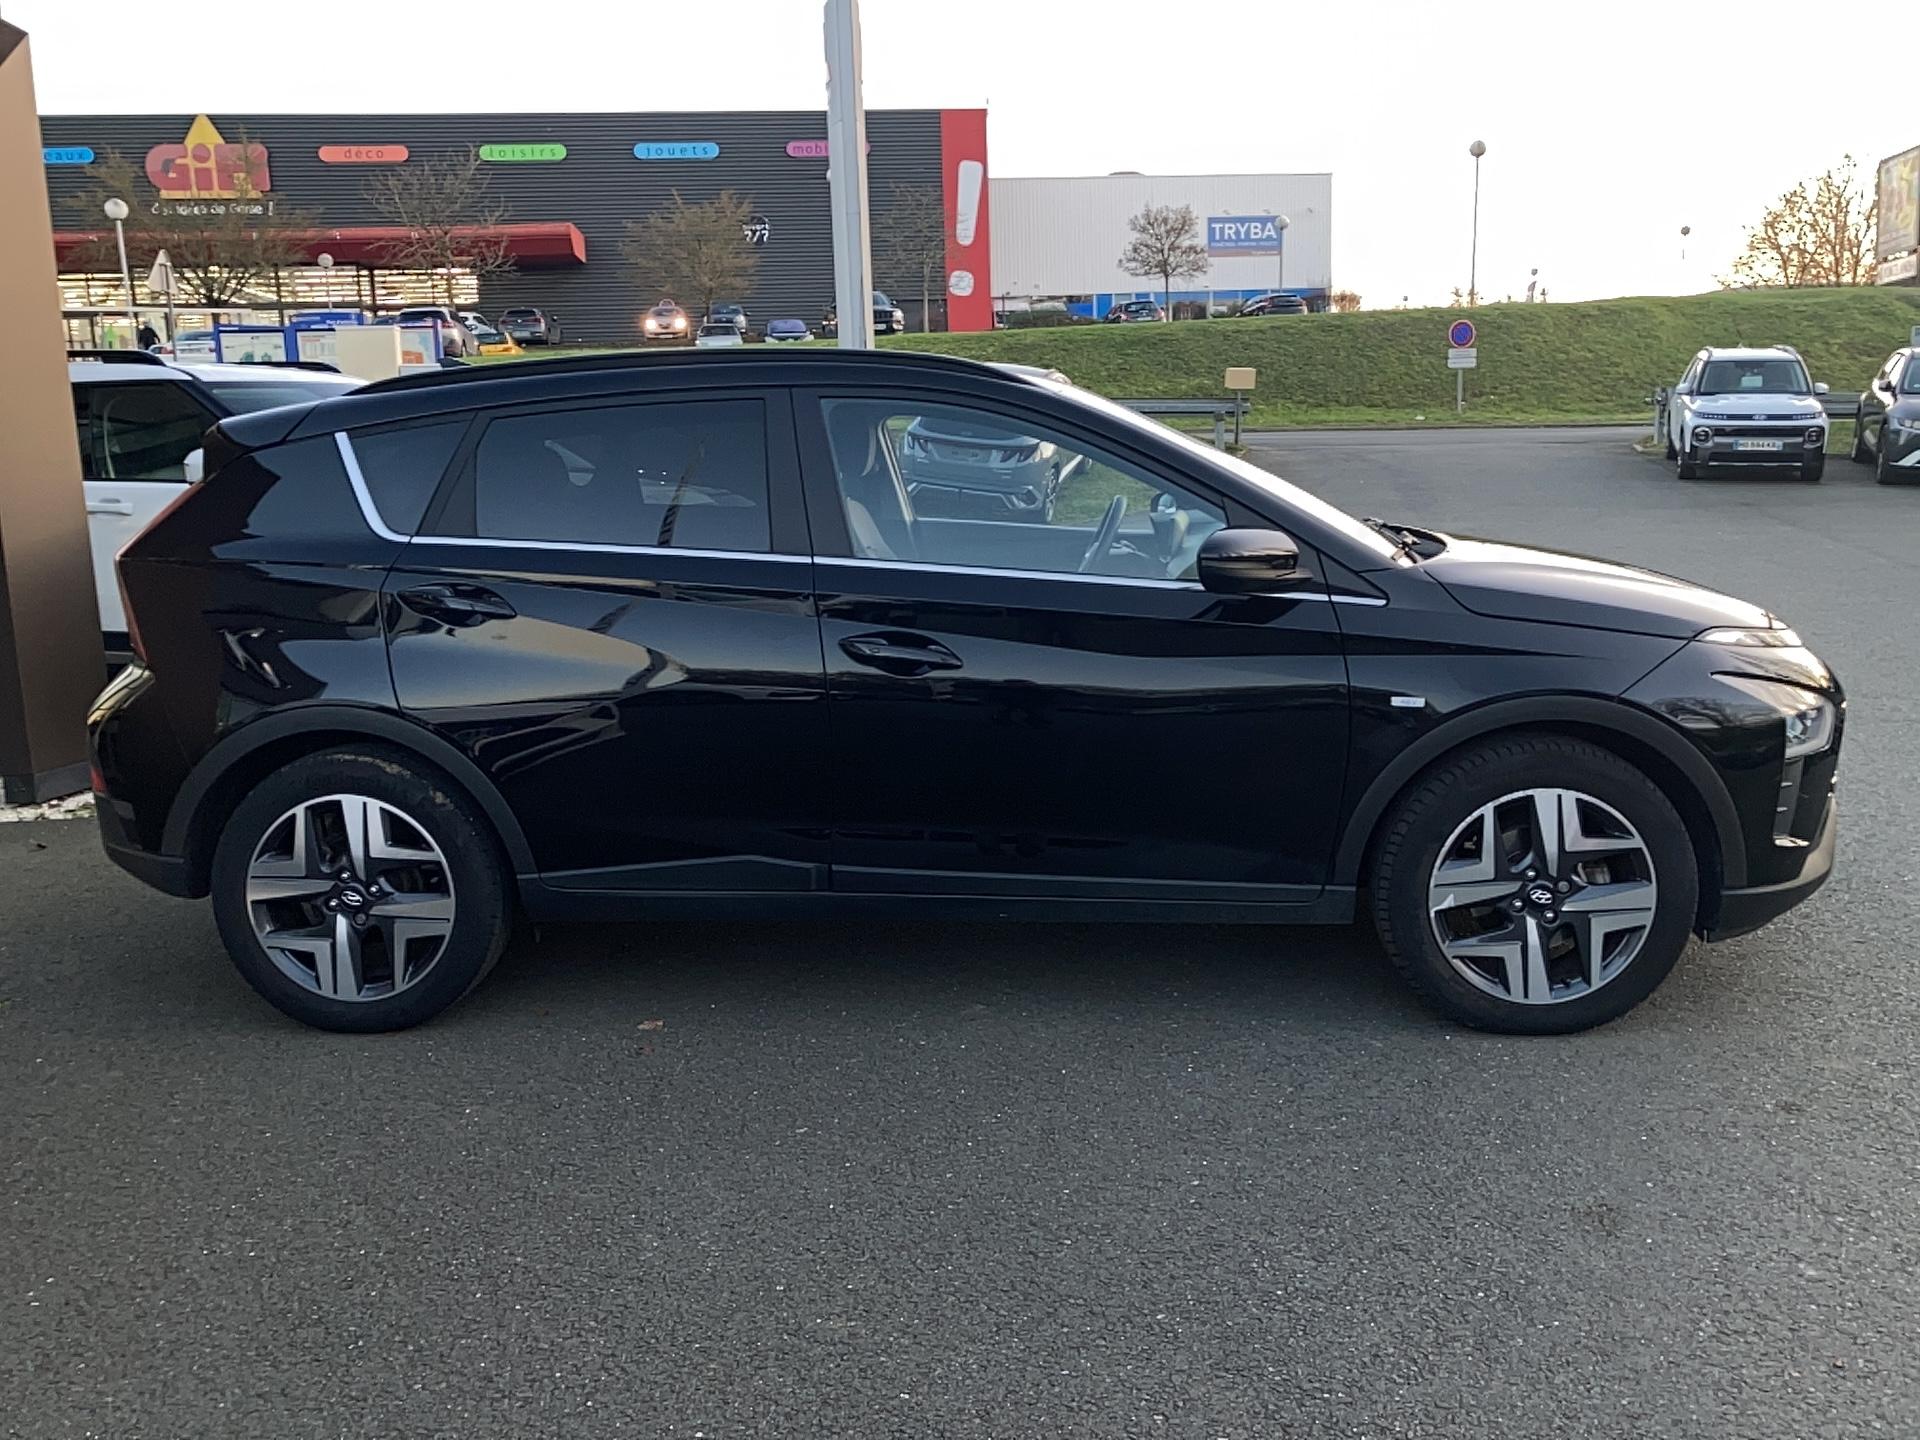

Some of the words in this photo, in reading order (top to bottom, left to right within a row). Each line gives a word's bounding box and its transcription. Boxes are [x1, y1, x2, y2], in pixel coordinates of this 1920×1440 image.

[489, 146, 557, 159] loisirs
[646, 145, 709, 157] jouets
[1211, 222, 1277, 240] TRYBA
